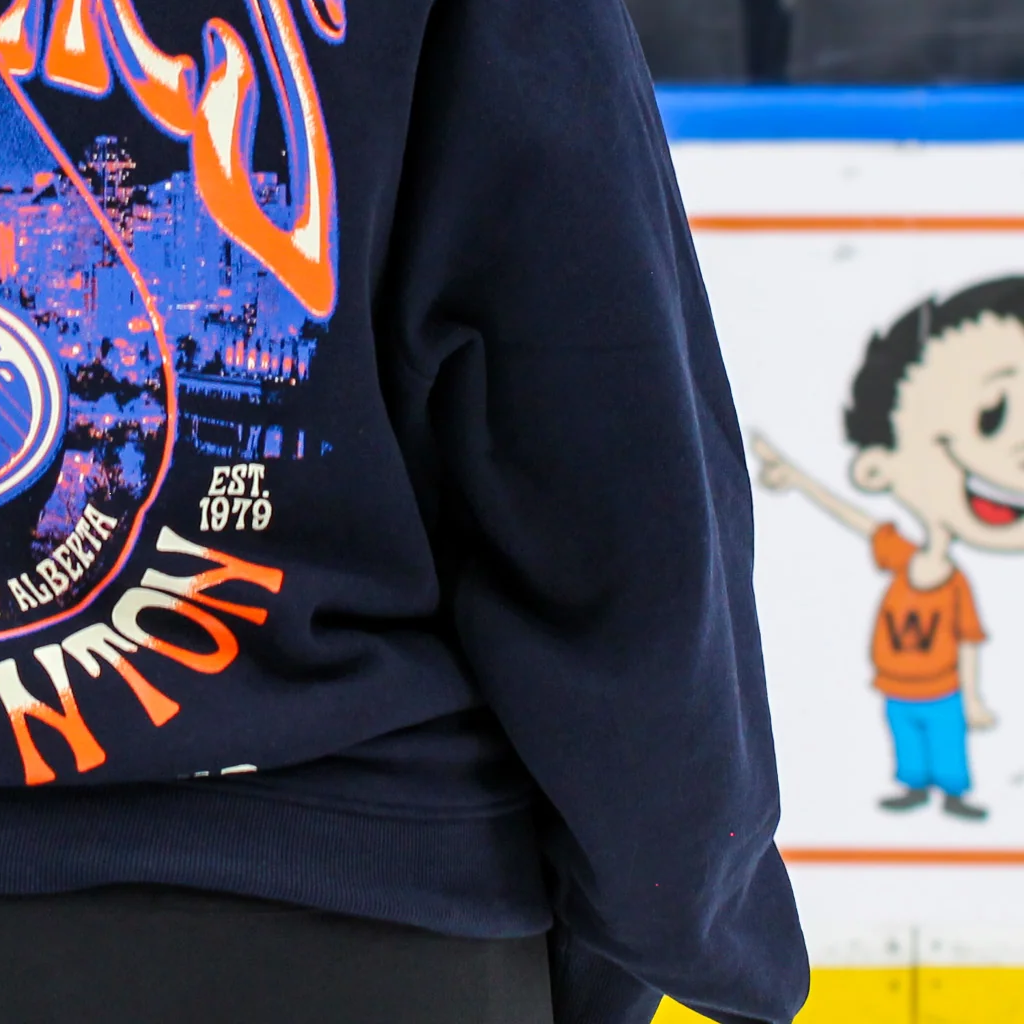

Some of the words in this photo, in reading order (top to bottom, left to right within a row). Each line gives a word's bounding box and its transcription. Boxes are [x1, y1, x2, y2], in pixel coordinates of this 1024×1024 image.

[208, 463, 270, 498] EST.
[199, 496, 272, 532] 1979
[7, 503, 118, 612] ALBERTA
